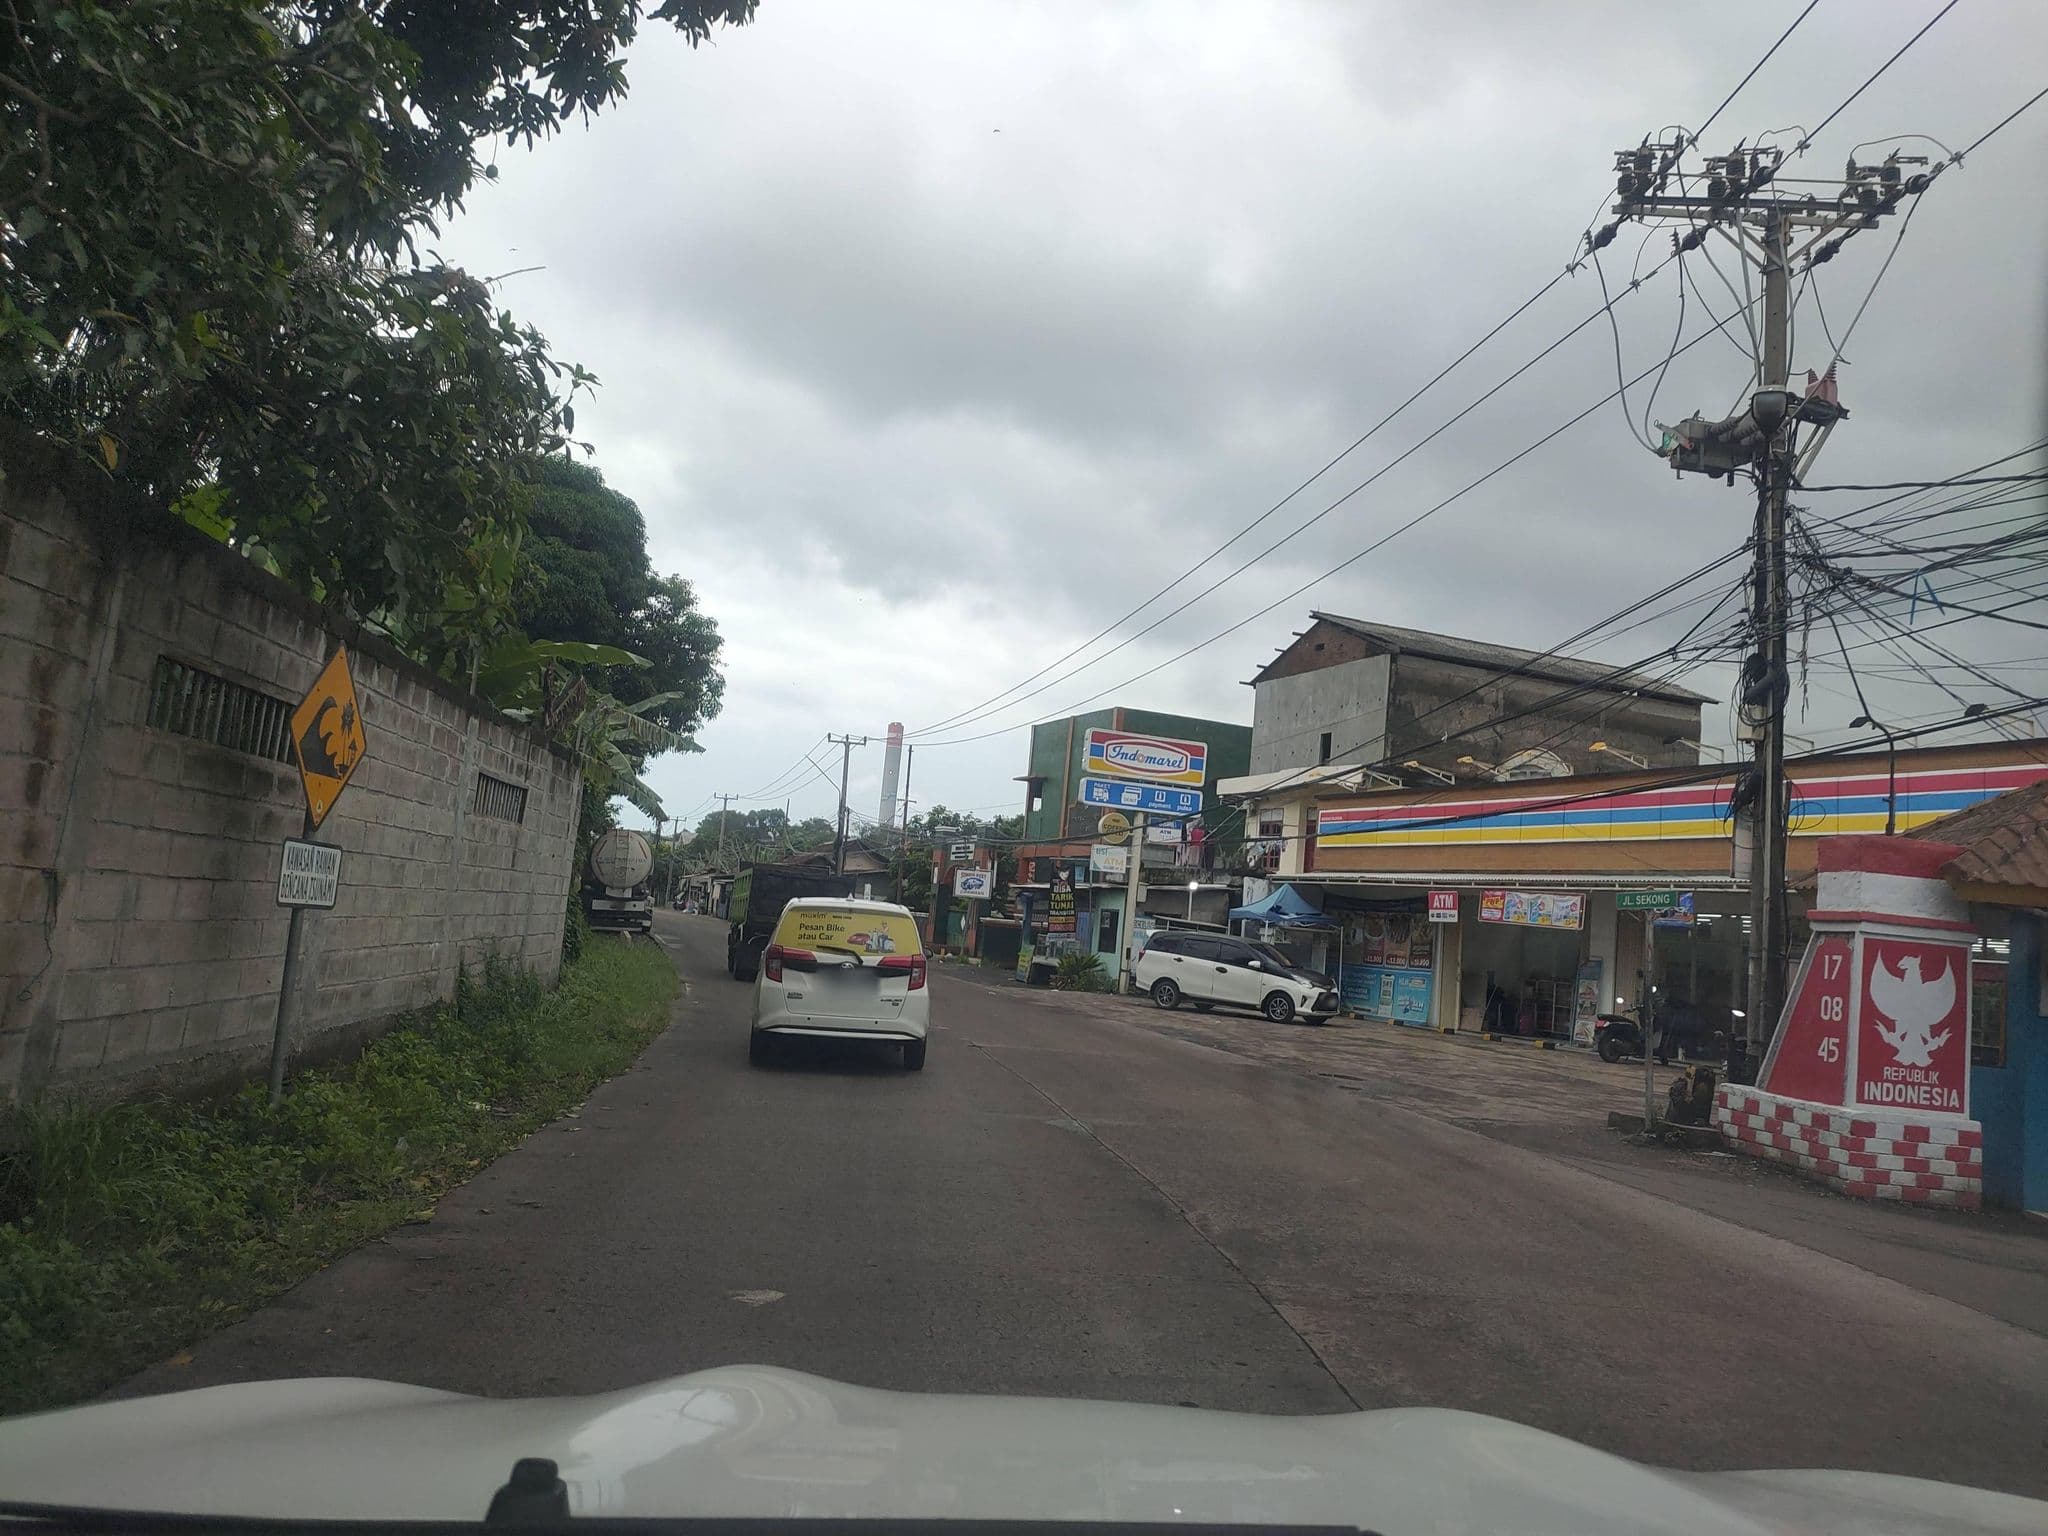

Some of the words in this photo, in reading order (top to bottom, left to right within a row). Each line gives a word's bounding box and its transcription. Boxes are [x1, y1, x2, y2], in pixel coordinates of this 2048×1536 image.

[1109, 746, 1184, 768] Indomaret
[1050, 893, 1074, 901] TARIK
[1050, 901, 1074, 909] TUNAI
[1433, 894, 1454, 909] ATM
[1636, 894, 1670, 905] SEKONG
[799, 923, 824, 931] Pesan
[826, 923, 845, 932] Bike
[798, 932, 816, 940] atau
[818, 932, 834, 941] Car
[1823, 955, 1843, 980] 17
[1820, 995, 1843, 1022] 08
[1817, 1036, 1840, 1063] 45
[1883, 1066, 1940, 1084] REPUBLIK
[1864, 1081, 1960, 1108] INDONESIA
